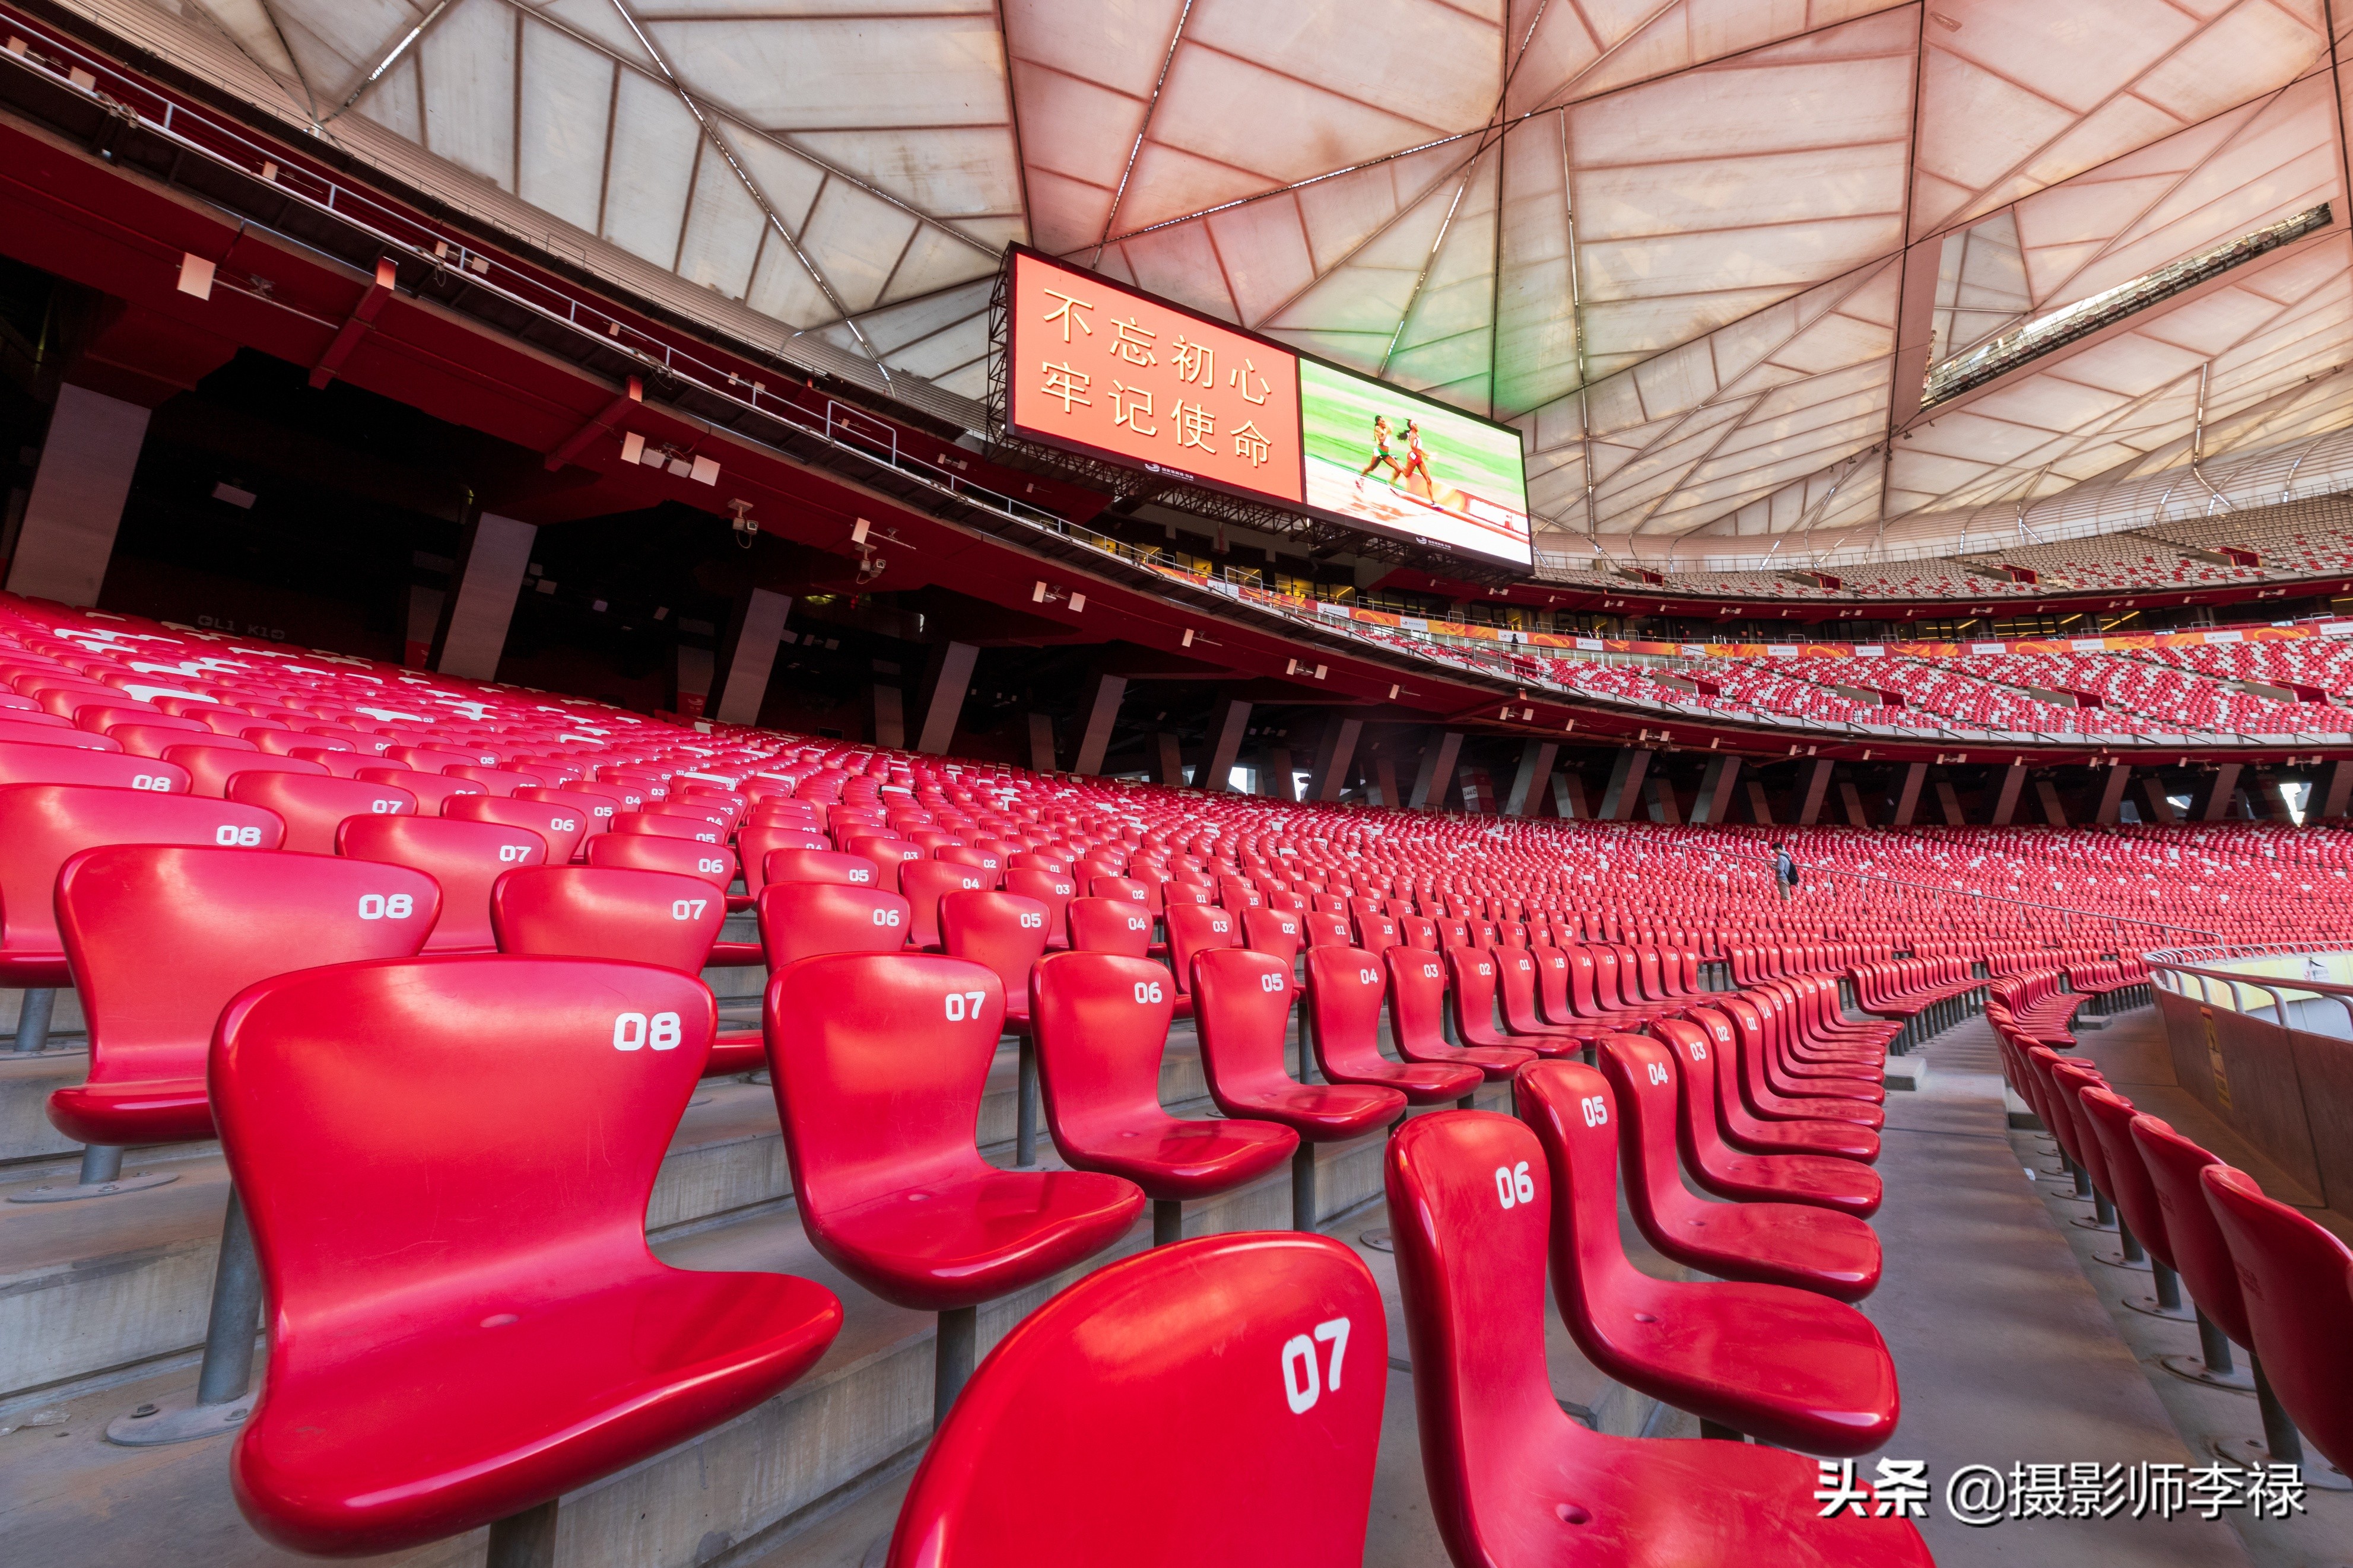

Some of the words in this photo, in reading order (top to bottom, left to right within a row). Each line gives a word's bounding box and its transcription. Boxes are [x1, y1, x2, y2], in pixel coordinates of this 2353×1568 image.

[1043, 288, 1272, 406] 不忘初心
[1041, 361, 1272, 468] 牢记使命
[132, 774, 171, 791] 08
[625, 796, 641, 804] 04
[371, 799, 403, 814] 07
[594, 807, 612, 816] 05
[551, 818, 574, 832] 06
[216, 825, 262, 846] 08
[696, 833, 716, 843] 05
[499, 845, 531, 863] 07
[903, 851, 918, 860] 03
[698, 858, 723, 873] 06
[983, 859, 996, 868] 02
[1050, 864, 1060, 873] 01
[849, 869, 869, 882] 05
[962, 878, 980, 889] 04
[1202, 879, 1211, 887] 14
[1055, 884, 1070, 895] 03
[1132, 890, 1145, 899] 02
[1196, 894, 1206, 903] 01
[1249, 897, 1259, 905] 15
[358, 893, 413, 920] 08
[873, 909, 899, 926] 06
[1020, 912, 1041, 928] 05
[1128, 917, 1146, 930] 04
[1212, 920, 1228, 932] 03
[1282, 923, 1295, 934] 02
[1335, 925, 1346, 935] 01
[1383, 925, 1393, 934] 15
[1423, 927, 1432, 936] 14
[1456, 927, 1463, 936] 13
[1484, 927, 1492, 936] 12
[1555, 958, 1565, 968] 15
[1582, 957, 1591, 966] 14
[1605, 955, 1615, 964] 13
[1649, 953, 1657, 962] 11
[1424, 964, 1439, 978] 03
[1479, 963, 1491, 975] 02
[1519, 959, 1530, 971] 01
[1360, 968, 1378, 984] 04
[1262, 973, 1284, 992] 05
[1806, 984, 1815, 993] 10
[1819, 981, 1827, 990] 09
[1827, 979, 1836, 988] 08
[1135, 981, 1162, 1004] 06
[1783, 992, 1792, 1003] 12
[1796, 988, 1803, 998] 11
[945, 991, 986, 1021] 07
[1773, 998, 1782, 1010] 13
[1761, 1006, 1771, 1019] 14
[1746, 1016, 1758, 1031] 01
[613, 1012, 681, 1051] 08
[1716, 1025, 1730, 1042] 02
[1690, 1041, 1706, 1061] 03
[1647, 1062, 1668, 1085] 04
[1582, 1096, 1608, 1127] 05
[1495, 1161, 1534, 1209] 06
[1282, 1317, 1350, 1414] 07
